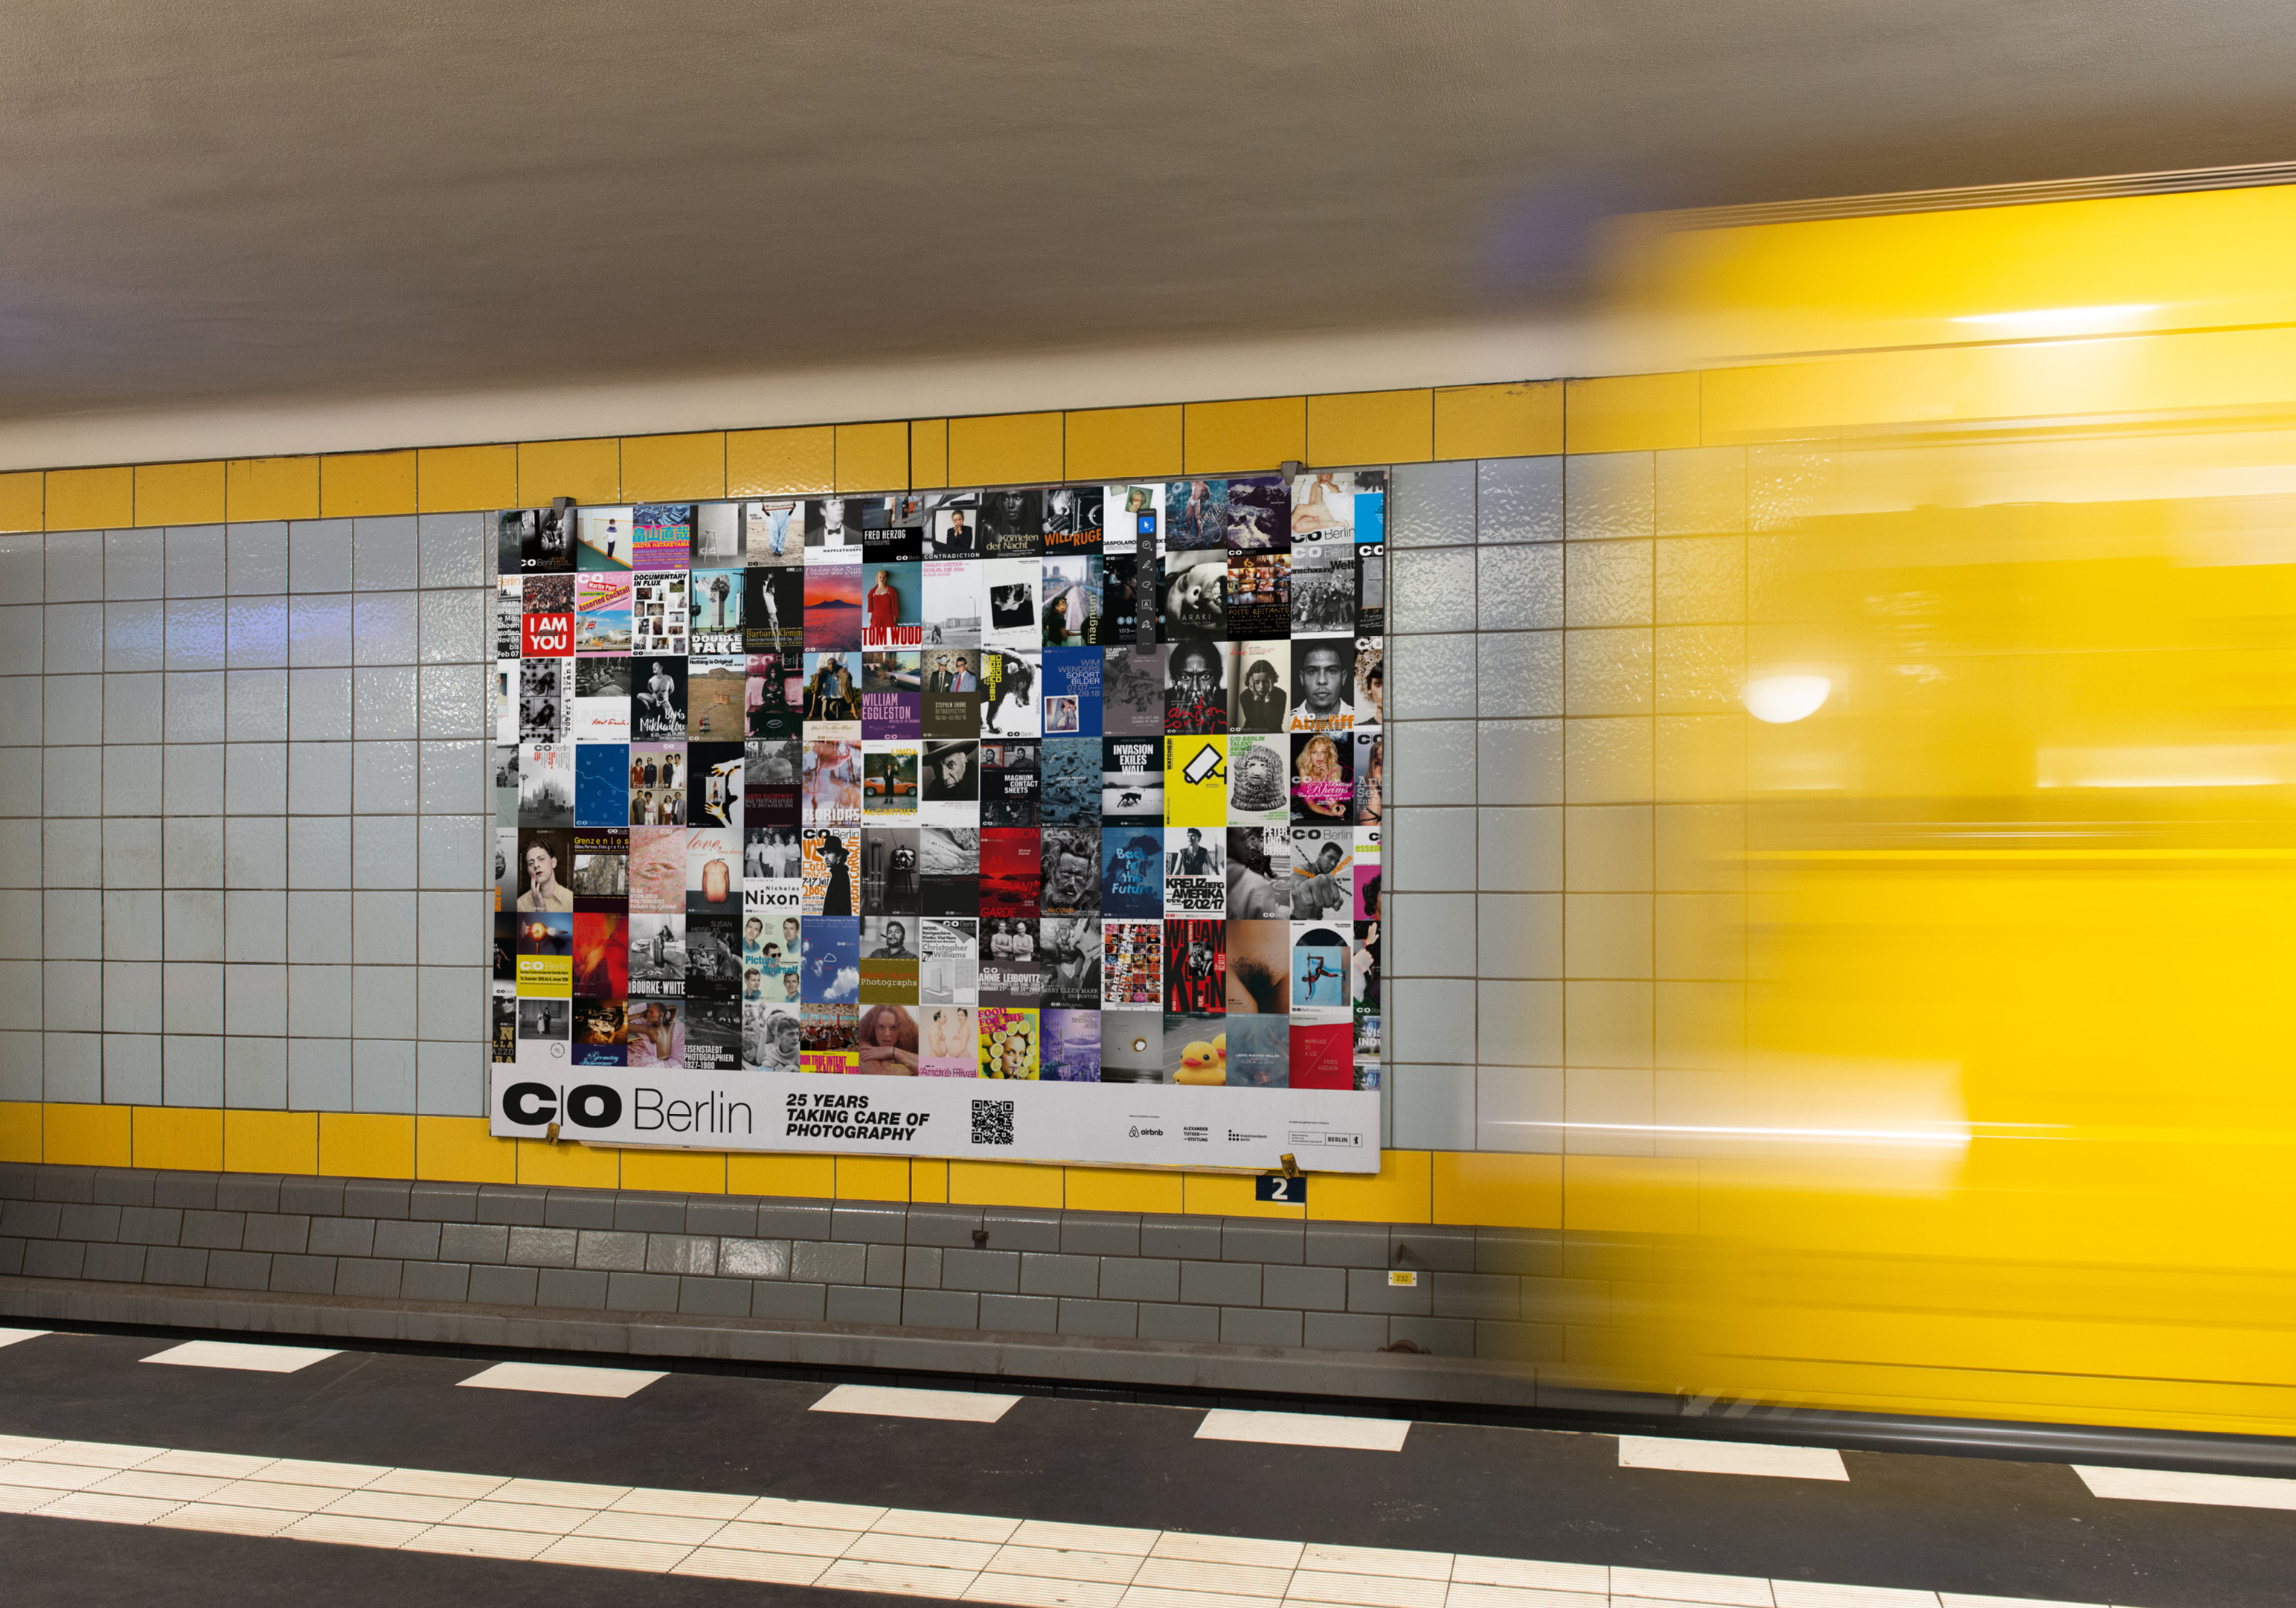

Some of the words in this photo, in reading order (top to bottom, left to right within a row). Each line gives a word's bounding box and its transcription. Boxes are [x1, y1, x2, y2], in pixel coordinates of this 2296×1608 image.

[865, 531, 879, 540] FRED
[882, 529, 905, 539] HERZOG
[1000, 534, 1039, 543] Kometen
[1073, 528, 1102, 547] RUGE
[1324, 527, 1355, 540] Berlin
[986, 542, 1001, 551] der
[1004, 542, 1028, 551] Nacht
[1324, 545, 1354, 558] Berlin
[1330, 560, 1355, 571] Welt
[633, 571, 687, 582] DOCUMENTARY
[805, 566, 829, 577] Under
[831, 566, 843, 576] the
[844, 566, 862, 575] Sun
[589, 582, 604, 591] Martin
[578, 595, 606, 612] Assorted
[606, 586, 631, 601] Cocktail
[530, 618, 535, 632] I
[539, 617, 568, 632] AM
[746, 630, 776, 638] Barbara
[862, 627, 887, 646] TOM
[891, 626, 922, 645] WOOD
[530, 634, 568, 650] YOU
[690, 642, 742, 654] TAKE
[862, 694, 898, 706] WILLIAM
[862, 706, 911, 720] EGGLESTON
[1113, 744, 1153, 755] INVASION
[1120, 755, 1147, 765] EXILES
[1122, 766, 1145, 775] WALL
[804, 807, 861, 821] FLORIDAS
[982, 829, 1041, 839] MIGRATION
[1324, 829, 1352, 840] Berlin
[574, 836, 629, 845] Grenzenlos
[1116, 848, 1147, 859] Back
[989, 856, 1003, 865] AS
[1126, 859, 1138, 870] to
[1331, 855, 1353, 876] HOEPKER
[802, 861, 827, 874] Foto
[1292, 866, 1315, 879] THOMAS
[1121, 873, 1144, 883] the
[1165, 878, 1225, 888] KREUZBERG
[802, 885, 827, 897] 2005
[1004, 880, 1033, 891] AVANT
[1112, 883, 1152, 894] Future
[745, 890, 799, 905] Nixon
[1180, 898, 1225, 910] 12/02/17
[980, 907, 1016, 917] GARDE
[923, 944, 969, 952] Christopher
[745, 955, 776, 965] Picture
[933, 951, 966, 959] Williams
[763, 965, 798, 974] Yourself
[861, 970, 885, 979] René
[889, 972, 917, 980] Burri
[861, 978, 917, 987] Photographs
[979, 973, 1001, 982] ANNIE
[1003, 974, 1040, 983] LEIBOVITZ
[978, 1007, 1007, 1018] FOOD
[979, 1017, 1001, 1026] FOR
[1005, 1012, 1024, 1021] THE
[980, 1024, 1007, 1035] EYES
[684, 1045, 722, 1054] EISENSTAEDT
[591, 1051, 619, 1063] Geometry
[684, 1054, 734, 1062] PHOTOGRAPHIEN
[800, 1054, 811, 1066] OUR
[811, 1054, 826, 1066] TRUE
[827, 1055, 847, 1066] INTENT
[684, 1061, 714, 1069] 1927-1980
[920, 1066, 952, 1077] André
[786, 1094, 807, 1106] 25
[814, 1094, 869, 1109] YEARS
[635, 1088, 751, 1134] Berlin
[786, 1109, 848, 1123] TAKING
[854, 1111, 901, 1125] CARE
[906, 1113, 930, 1126] OF
[786, 1124, 916, 1141] PHOTOGRAPHY
[1141, 1128, 1163, 1136] airbnb
[1272, 1177, 1289, 1200] 2
[1396, 1274, 1409, 1283] 232
